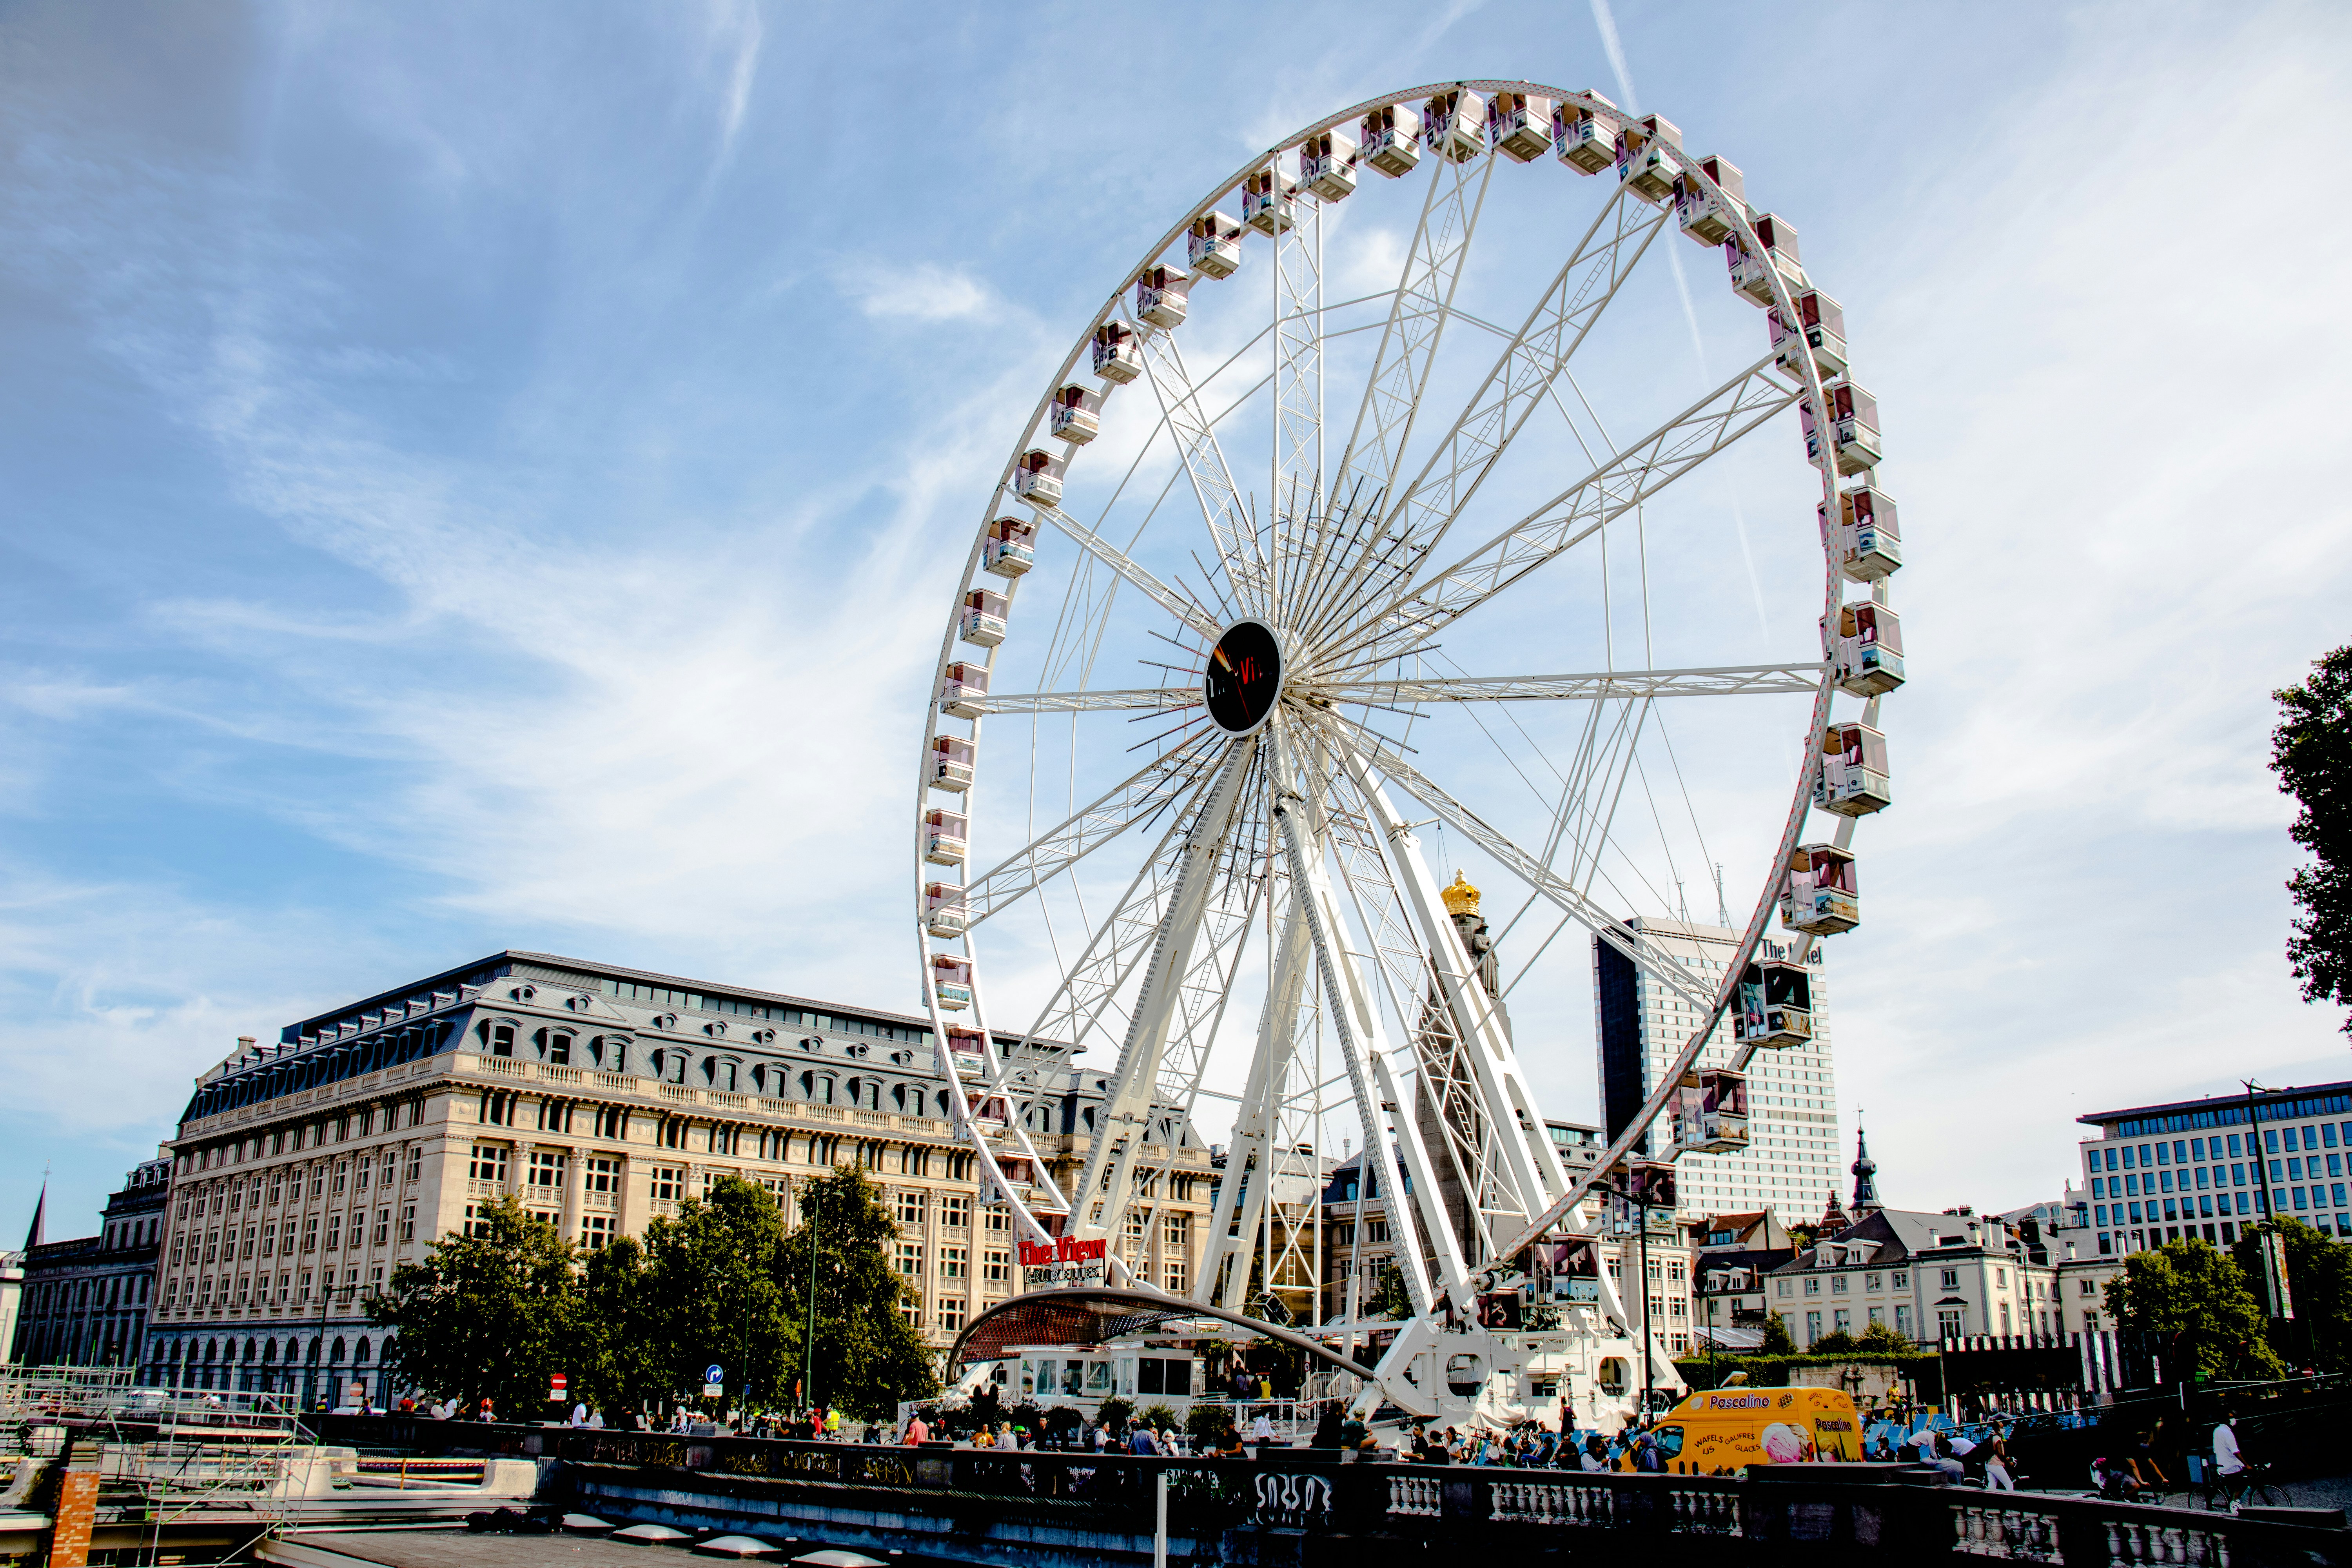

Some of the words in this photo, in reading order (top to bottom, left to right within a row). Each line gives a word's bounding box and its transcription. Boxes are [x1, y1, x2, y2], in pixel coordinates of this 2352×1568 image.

[1760, 938, 1785, 959] The
[1018, 1240, 1052, 1266] The
[1055, 1235, 1106, 1262] View
[1026, 1266, 1098, 1283] BRUXELLES
[1709, 1393, 1770, 1410] Pascalino
[1808, 1392, 1822, 1401] WAFELS
[1815, 1417, 1852, 1432] Pascalino
[1694, 1434, 1724, 1448] WAFELS
[1725, 1433, 1755, 1445] GAUFRES
[1735, 1444, 1760, 1452] GLACES
